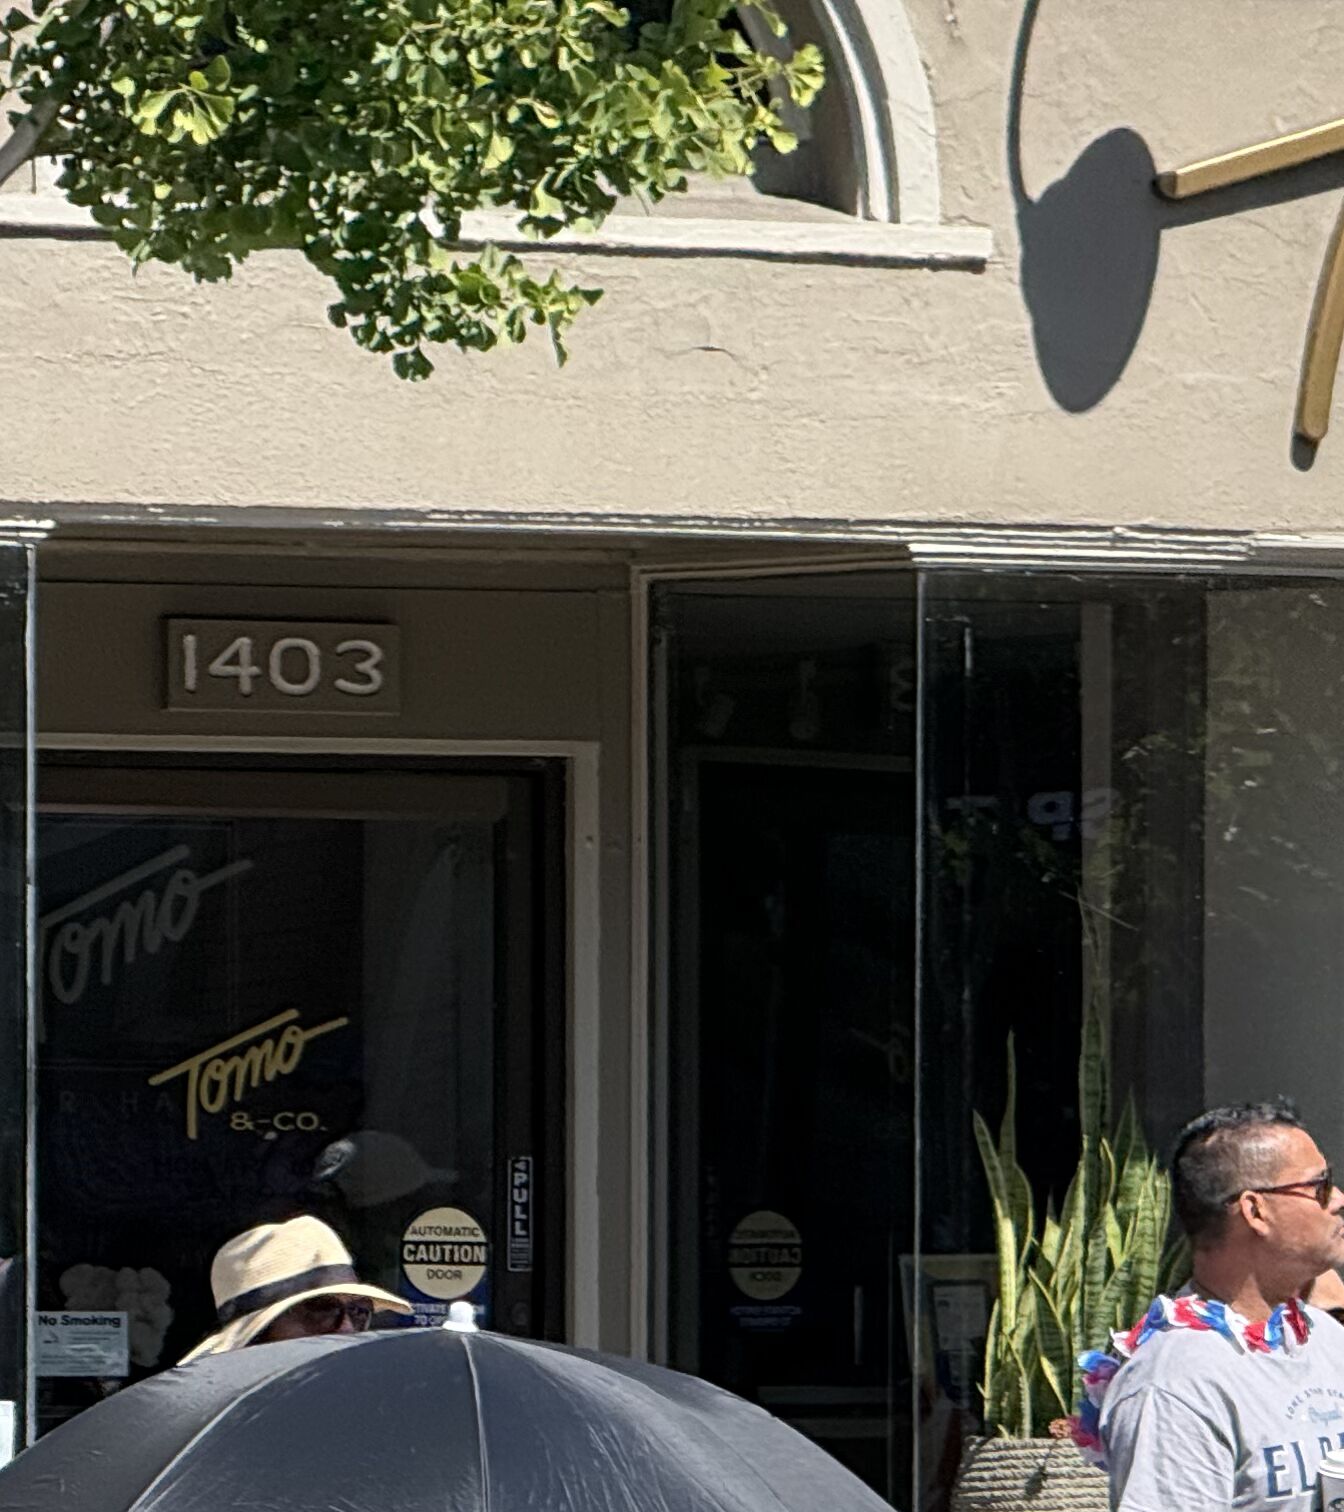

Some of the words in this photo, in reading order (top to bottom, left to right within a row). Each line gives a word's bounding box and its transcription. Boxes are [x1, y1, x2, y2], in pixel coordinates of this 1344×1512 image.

[182, 634, 384, 696] 1403
[148, 1009, 349, 1139] Tomo
[512, 1172, 529, 1236] PULL
[410, 1225, 481, 1237] AUTOMATIC
[403, 1244, 486, 1263] CAUTION
[426, 1269, 463, 1280] DOOR
[38, 1314, 57, 1326] No
[61, 1314, 121, 1328] Smoking
